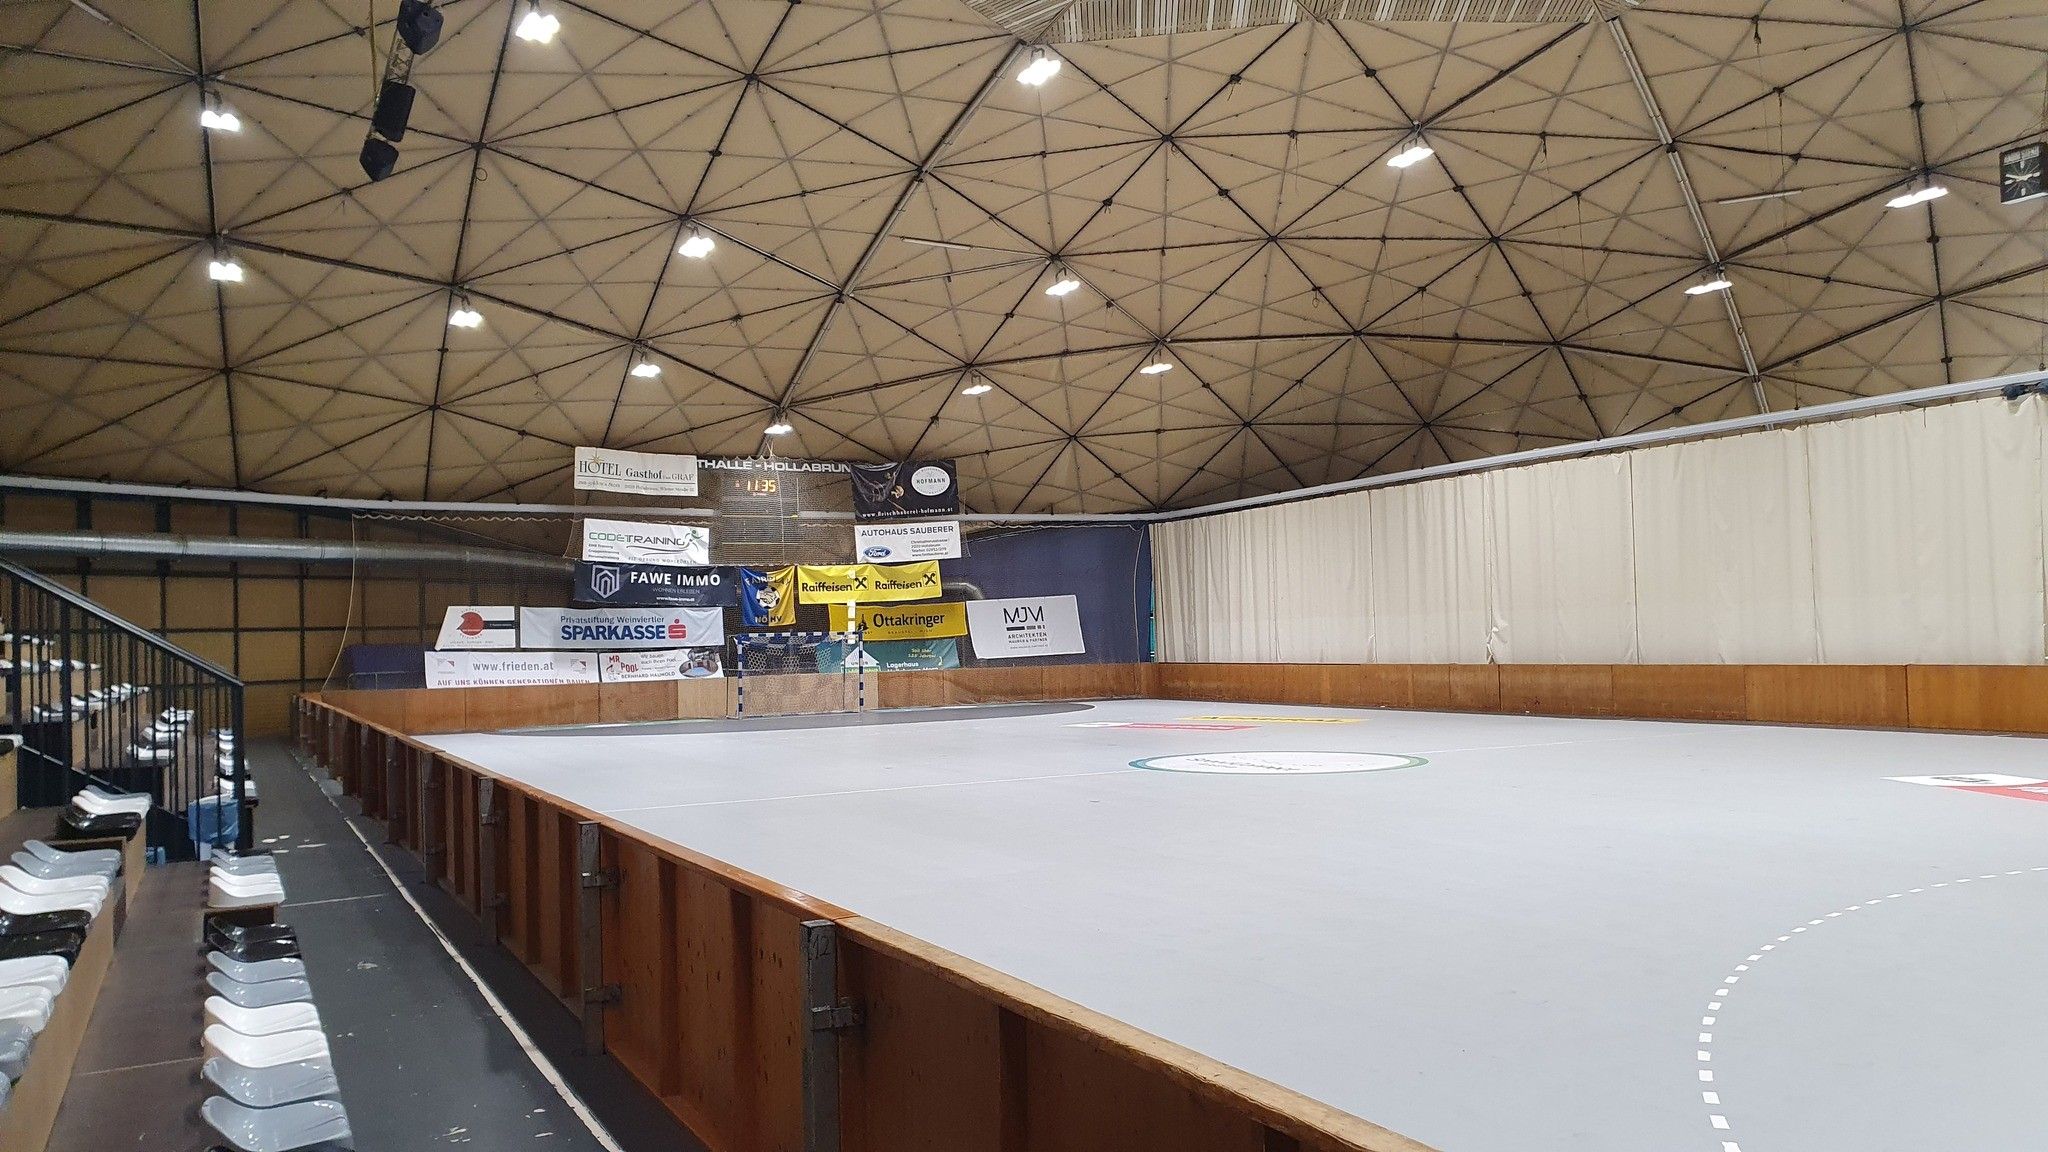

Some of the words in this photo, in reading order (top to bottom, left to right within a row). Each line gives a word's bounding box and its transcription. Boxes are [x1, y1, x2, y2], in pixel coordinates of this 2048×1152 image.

[579, 460, 621, 476] HOTEL
[625, 467, 662, 480] Gasthof
[671, 473, 695, 481] GRAF
[861, 528, 908, 537] AUTOHAUS
[910, 526, 954, 535] SAUBERER
[868, 548, 886, 557] Ford
[630, 571, 672, 585] FAWE
[677, 574, 721, 586] IMMO
[802, 581, 853, 592] Raiffeisen
[875, 579, 922, 590] Raiffeisen
[560, 615, 614, 625] Privatstiftung
[1003, 606, 1044, 624] MJM
[873, 613, 945, 629] Ottakringer
[561, 625, 666, 640] SPARKASSE
[609, 655, 620, 663] MR
[473, 661, 554, 671] www.frieden.at
[621, 662, 639, 673] POOL
[886, 661, 919, 669] Lagerhaus
